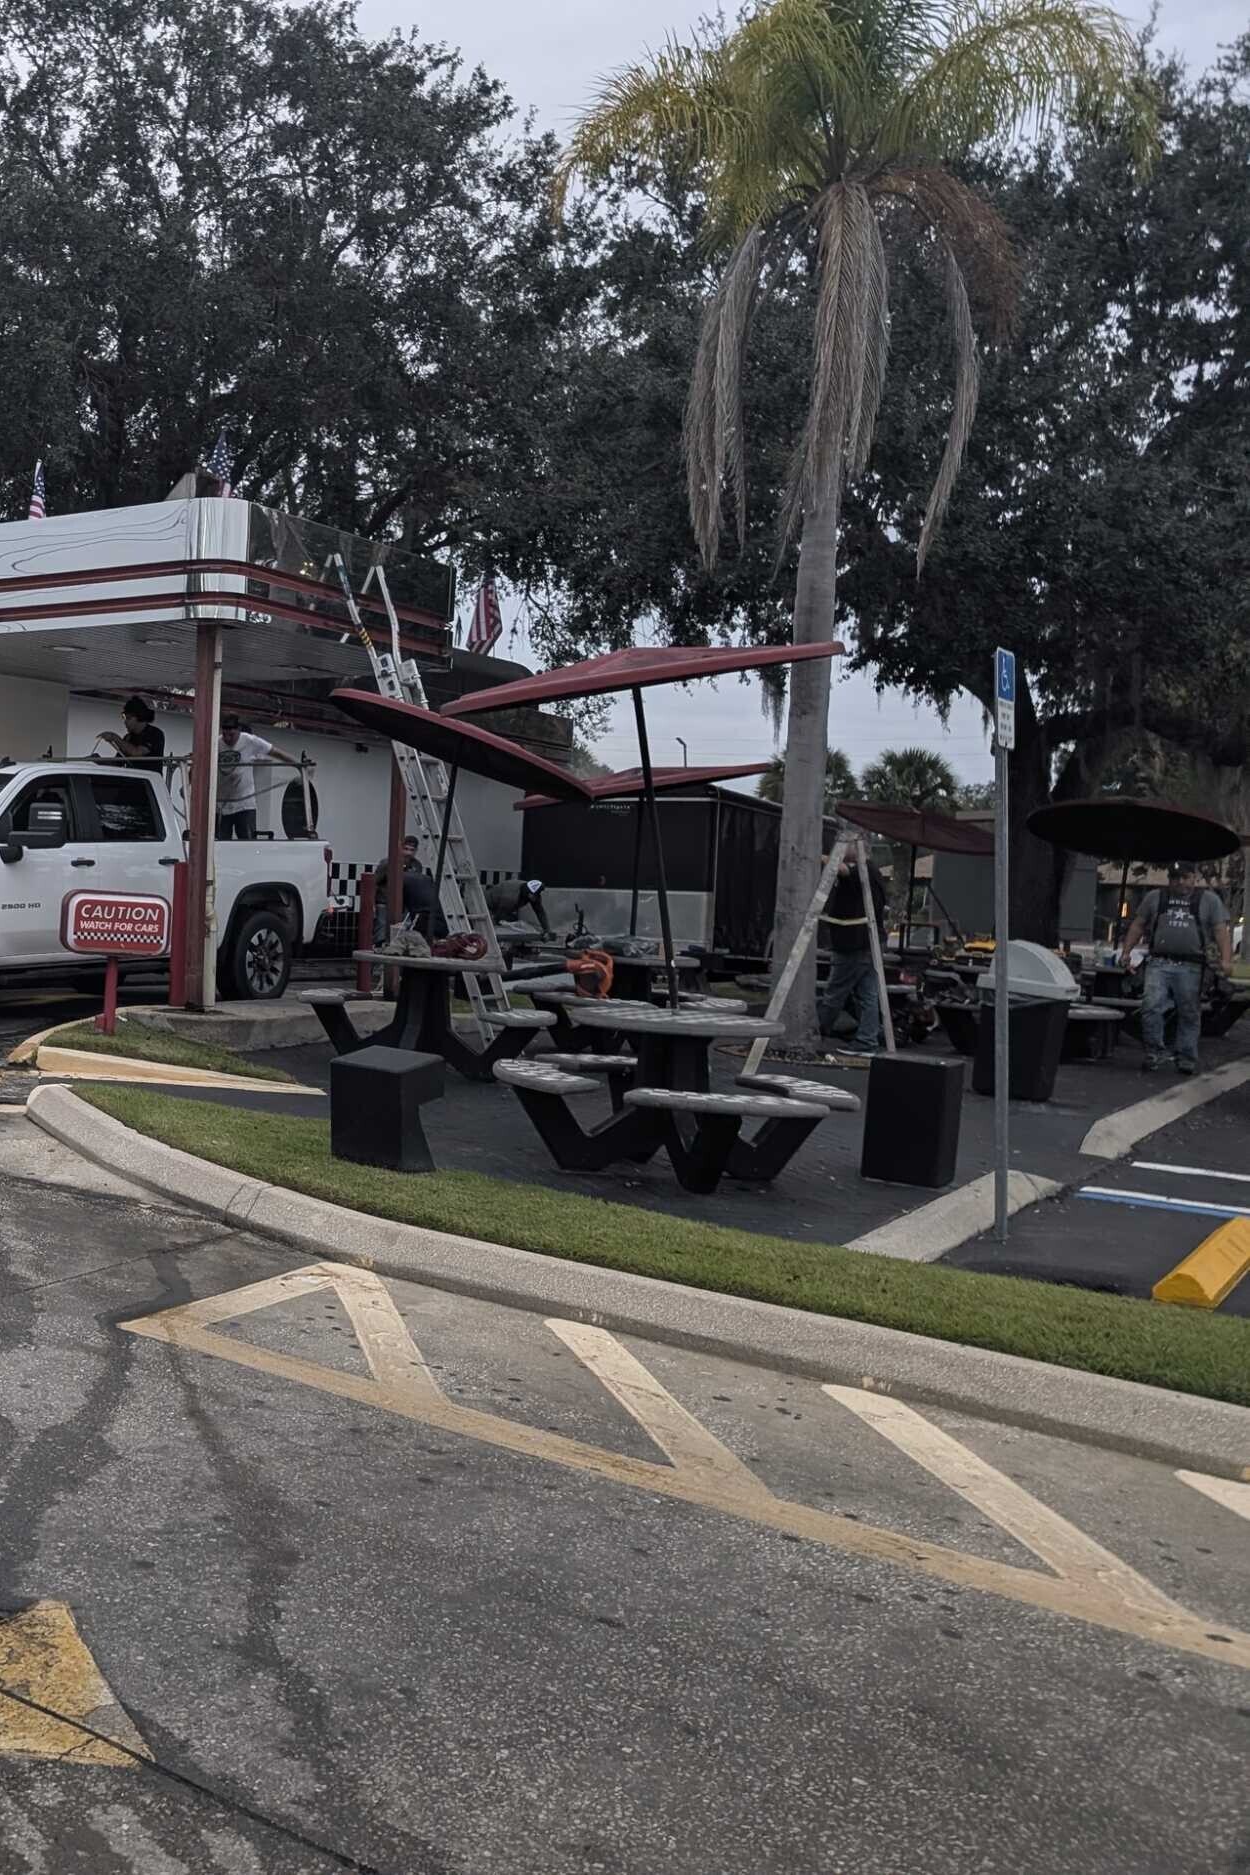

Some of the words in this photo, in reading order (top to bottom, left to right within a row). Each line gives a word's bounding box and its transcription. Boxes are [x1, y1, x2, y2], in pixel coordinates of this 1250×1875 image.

[81, 904, 160, 921] CAUTION
[79, 920, 112, 930] WATCH
[113, 922, 133, 932] FOR
[134, 923, 159, 933] CARS
